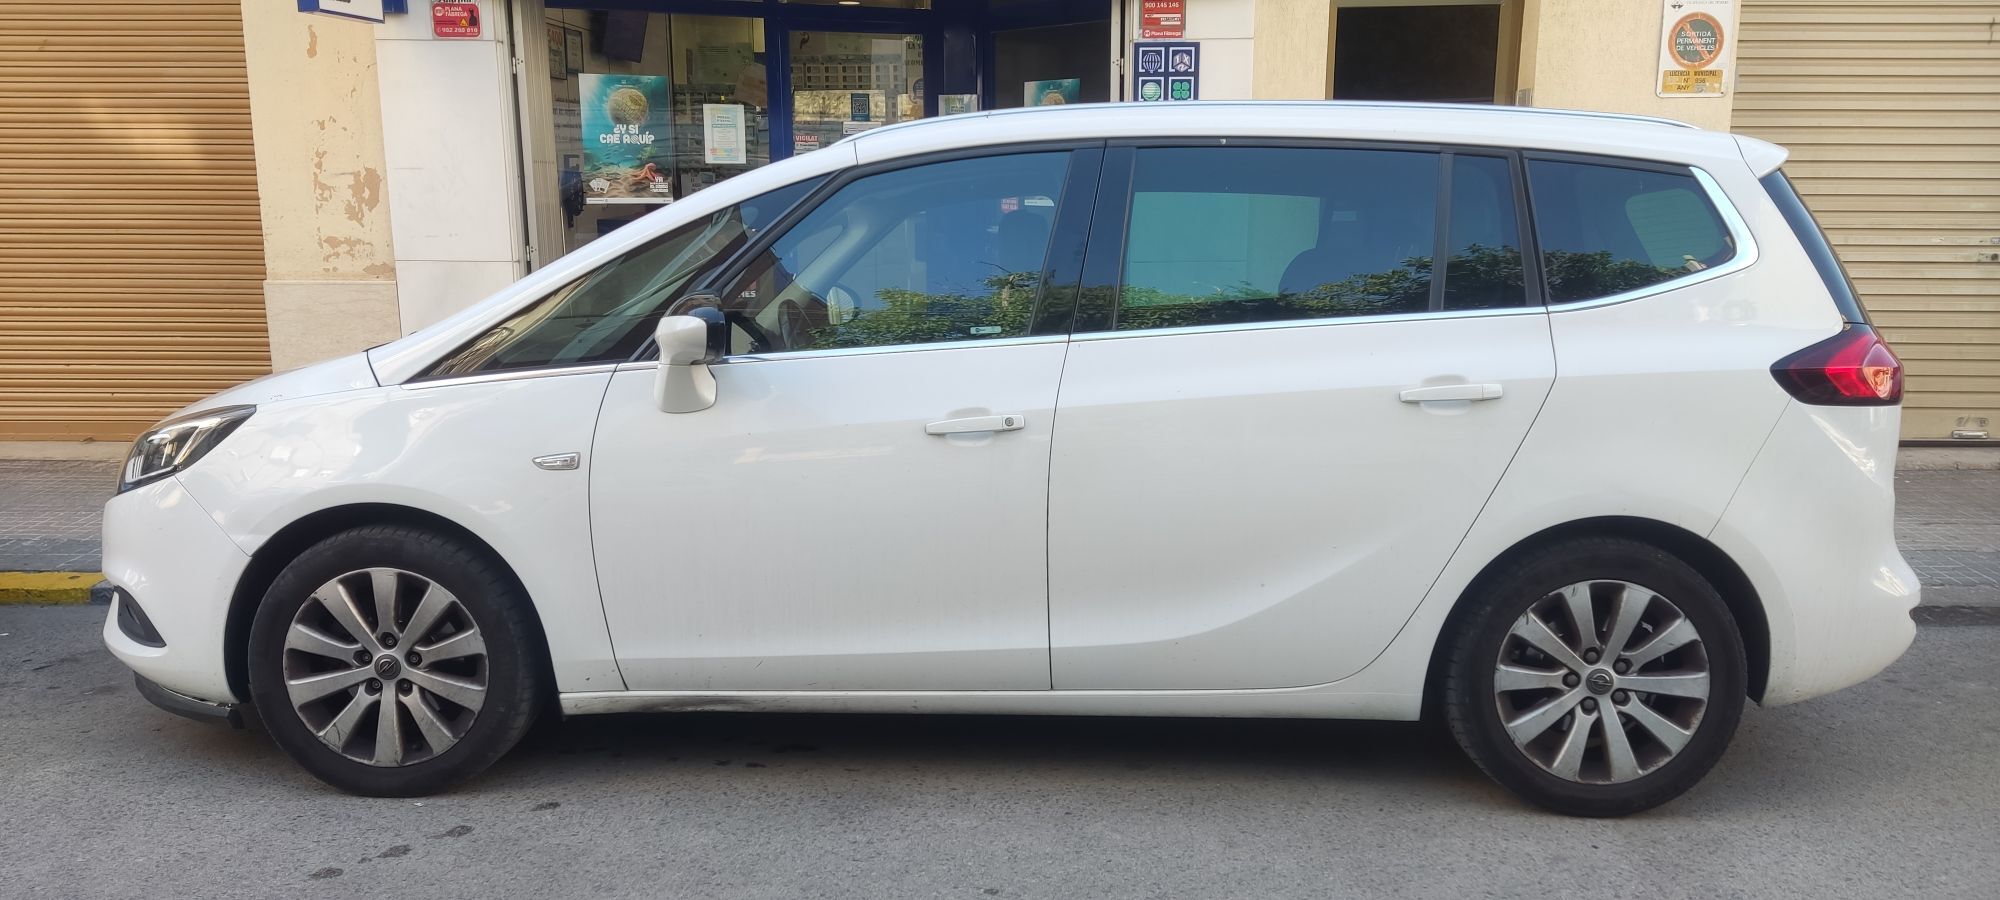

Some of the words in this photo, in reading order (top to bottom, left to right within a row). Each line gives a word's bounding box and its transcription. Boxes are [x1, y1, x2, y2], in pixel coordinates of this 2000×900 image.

[613, 124, 627, 134] ¿Y
[600, 133, 620, 144] CAE
[622, 131, 655, 145] AQUÍ?
